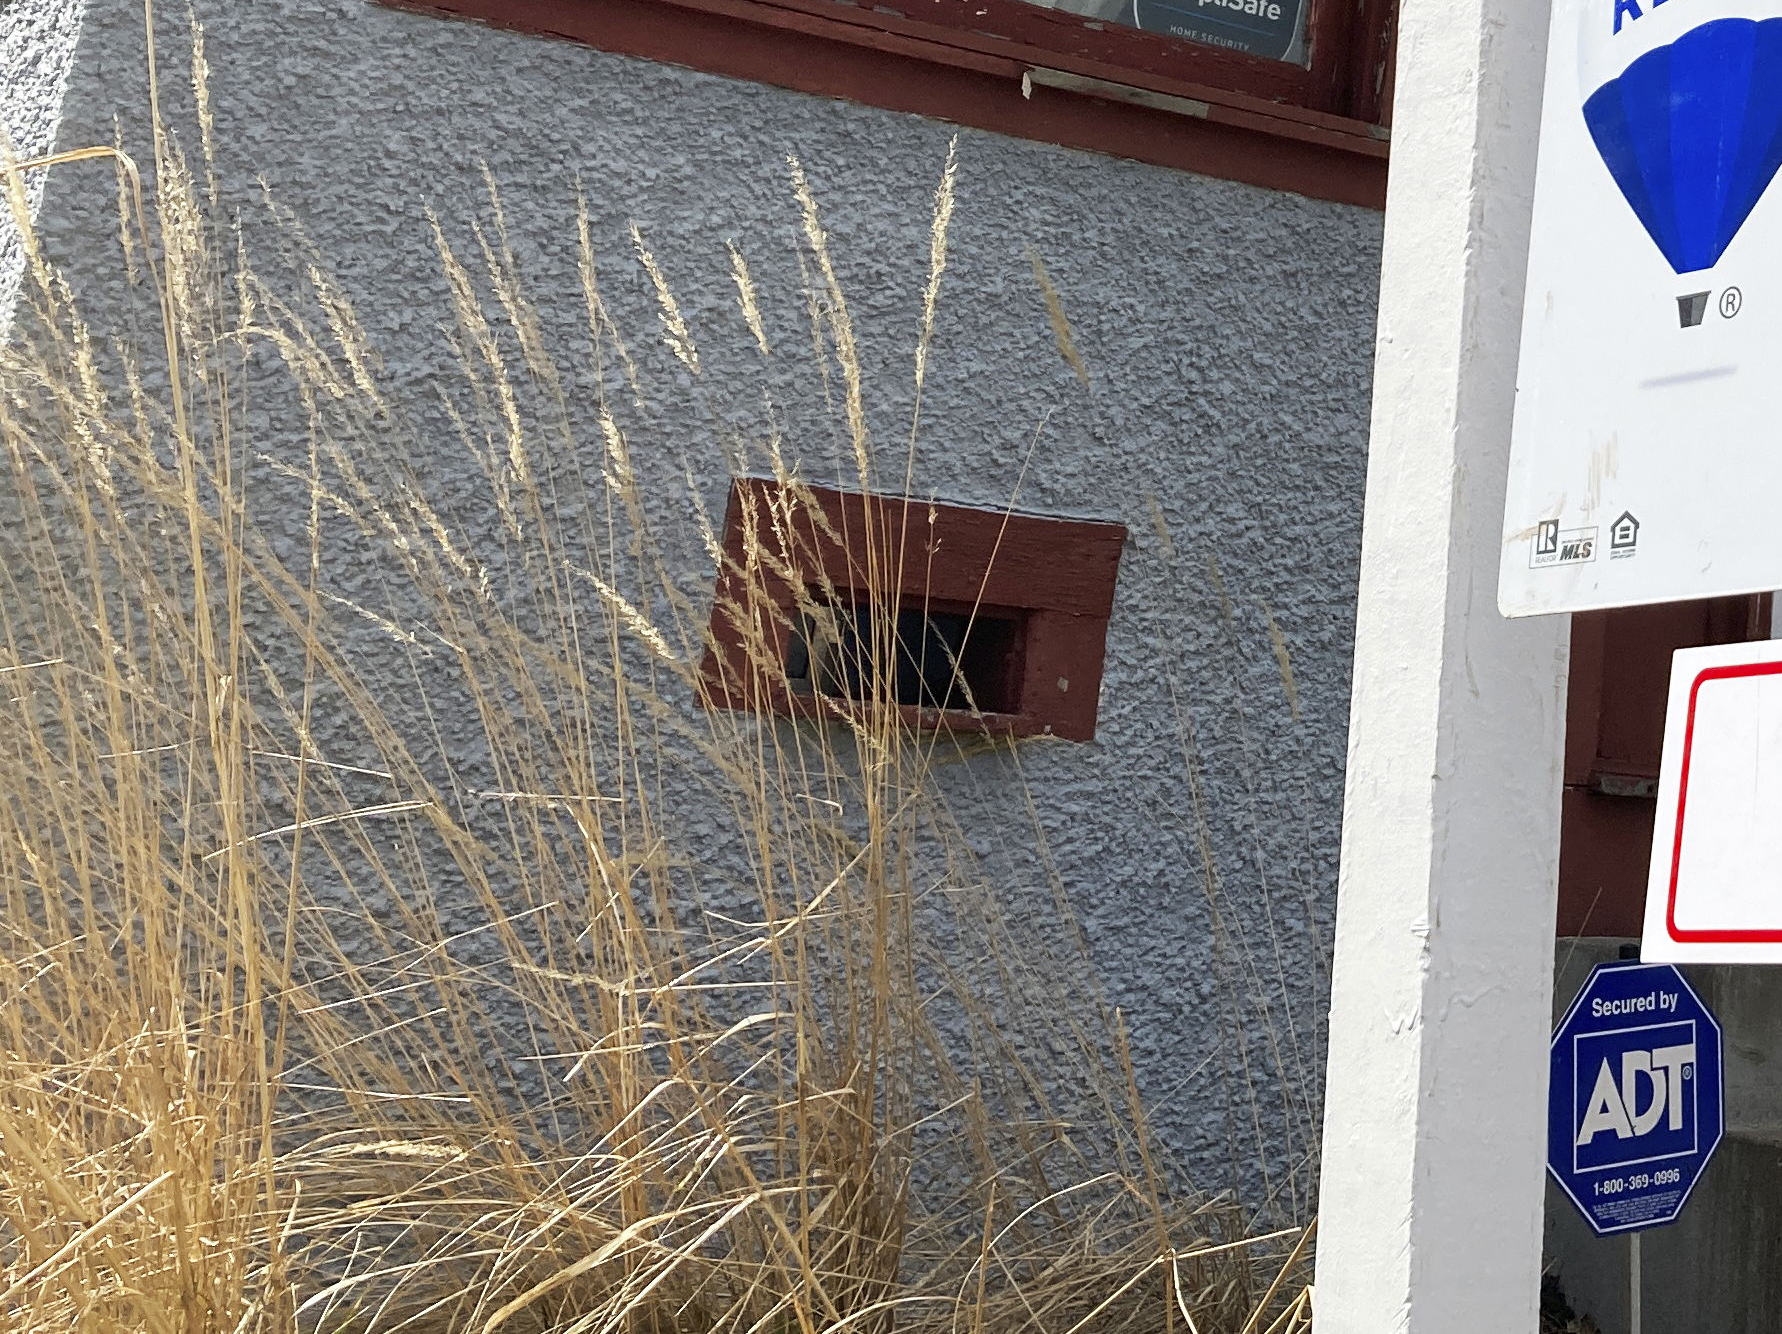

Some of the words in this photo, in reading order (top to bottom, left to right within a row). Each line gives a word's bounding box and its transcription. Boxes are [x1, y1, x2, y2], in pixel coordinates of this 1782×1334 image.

[1169, 24, 1198, 39] HOME
[1201, 33, 1251, 51] SECURITY
[1559, 541, 1593, 561] MLS
[1592, 992, 1656, 1017] Secured
[1660, 990, 1679, 1012] by
[1576, 1043, 1695, 1146] ADT
[1593, 1168, 1680, 1196] 1-800-369-0996
